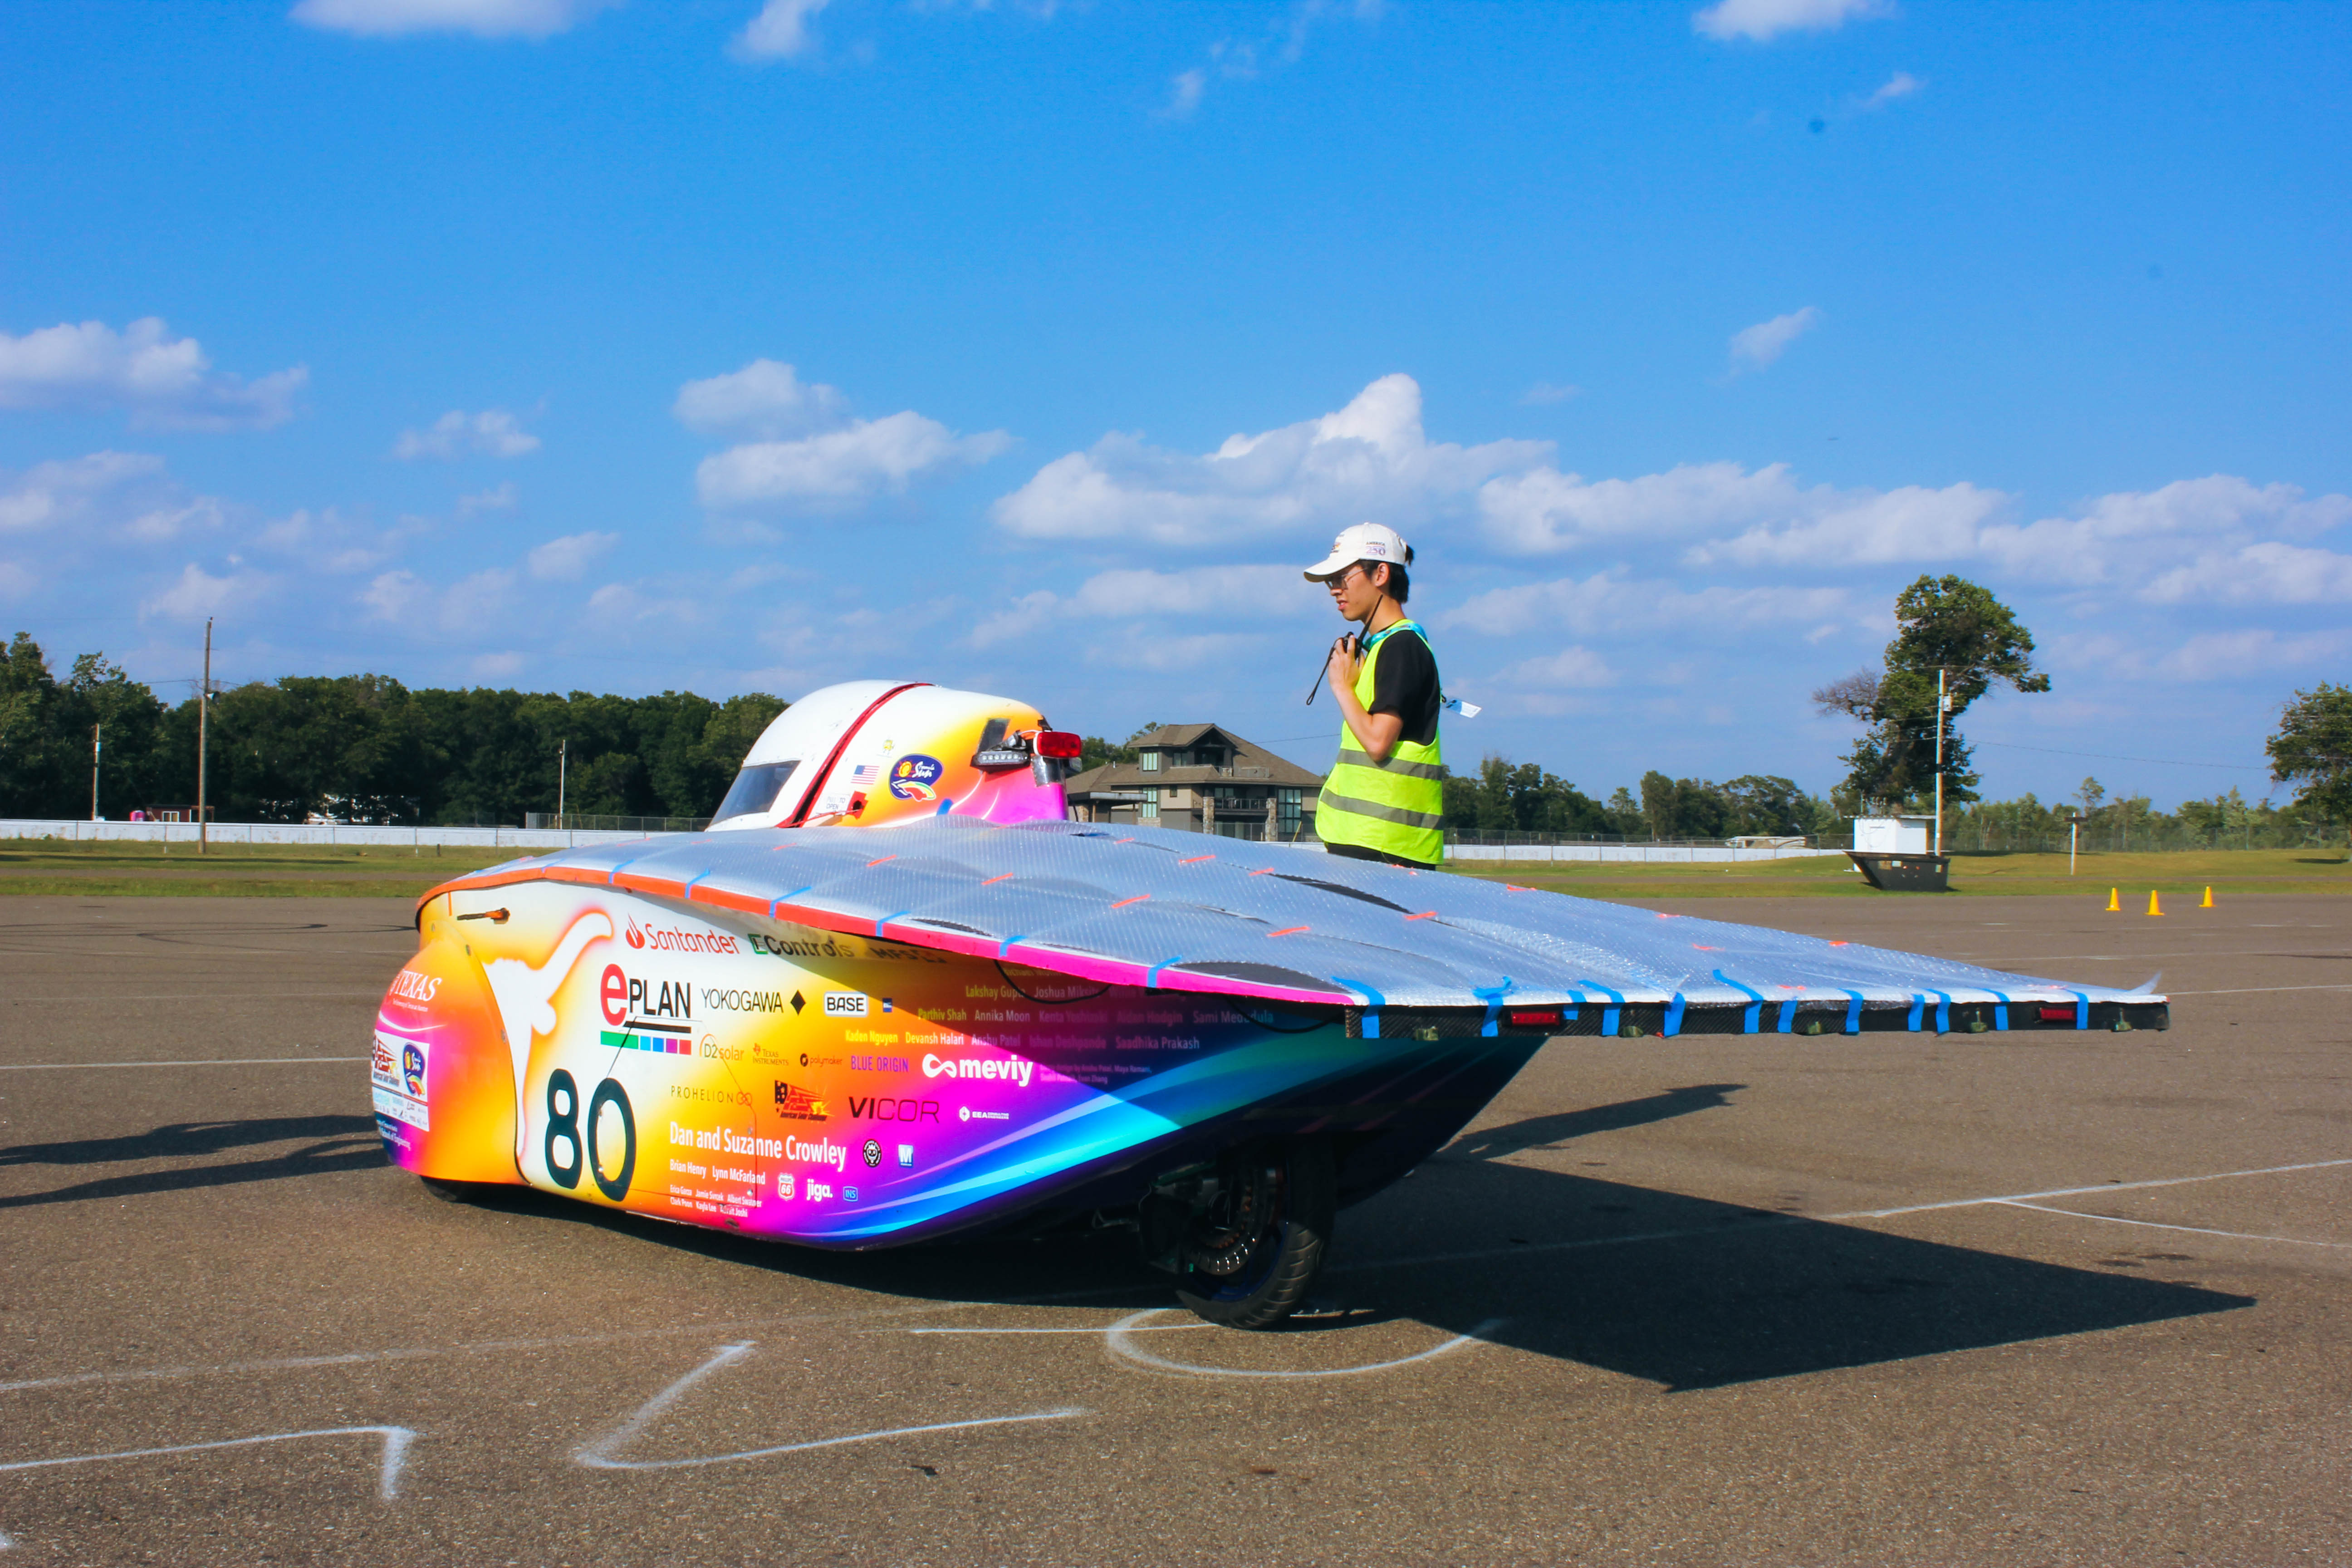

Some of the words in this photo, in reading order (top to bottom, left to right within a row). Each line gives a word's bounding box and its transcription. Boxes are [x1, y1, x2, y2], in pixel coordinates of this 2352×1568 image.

[1365, 546, 1386, 556] 250
[645, 923, 740, 954] Santander
[394, 970, 442, 1002] TEXAS
[965, 985, 999, 1001] Lakshay
[1034, 985, 1065, 998] Joshua
[701, 988, 784, 1013] YOKOGAWA
[827, 997, 864, 1012] BASE
[918, 1008, 946, 1021] Parthiv
[947, 1009, 966, 1021] Shah
[975, 1009, 1004, 1022] Annika
[1006, 1010, 1030, 1022] Moon
[1193, 1010, 1218, 1024] Sami
[845, 1029, 868, 1042] Kaden
[870, 1030, 898, 1046] Nguyen
[906, 1031, 938, 1044] Devansh
[940, 1032, 964, 1045] Halari
[1161, 1036, 1200, 1049] Prakash
[810, 1056, 843, 1067] polymaker
[851, 1055, 873, 1071] BLUE
[877, 1057, 909, 1072] ORIGIN
[960, 1054, 1034, 1087] meviy
[671, 1085, 733, 1103] PROHELION
[848, 1096, 939, 1123] VICOR
[545, 1068, 636, 1201] 80
[670, 1122, 693, 1146] Dan
[696, 1126, 720, 1151] and
[724, 1128, 782, 1158] Suzanne
[786, 1135, 846, 1172] Crowley
[670, 1158, 686, 1172] Brian
[687, 1161, 706, 1179] Henry
[712, 1165, 728, 1181] Lynn
[730, 1168, 765, 1185] McFarland
[670, 1185, 680, 1194] Erica
[681, 1186, 692, 1196] Garza
[696, 1189, 709, 1199] Jamie
[781, 1184, 791, 1194] 66
[806, 1178, 833, 1202] jiga.
[845, 1190, 856, 1199] INS
[670, 1197, 681, 1205] Clark
[681, 1199, 693, 1208] Poon
[696, 1201, 708, 1212] Kayla
[709, 1203, 717, 1212] Lee
[727, 1194, 741, 1205] Albert
[735, 1207, 748, 1218] Joshi
